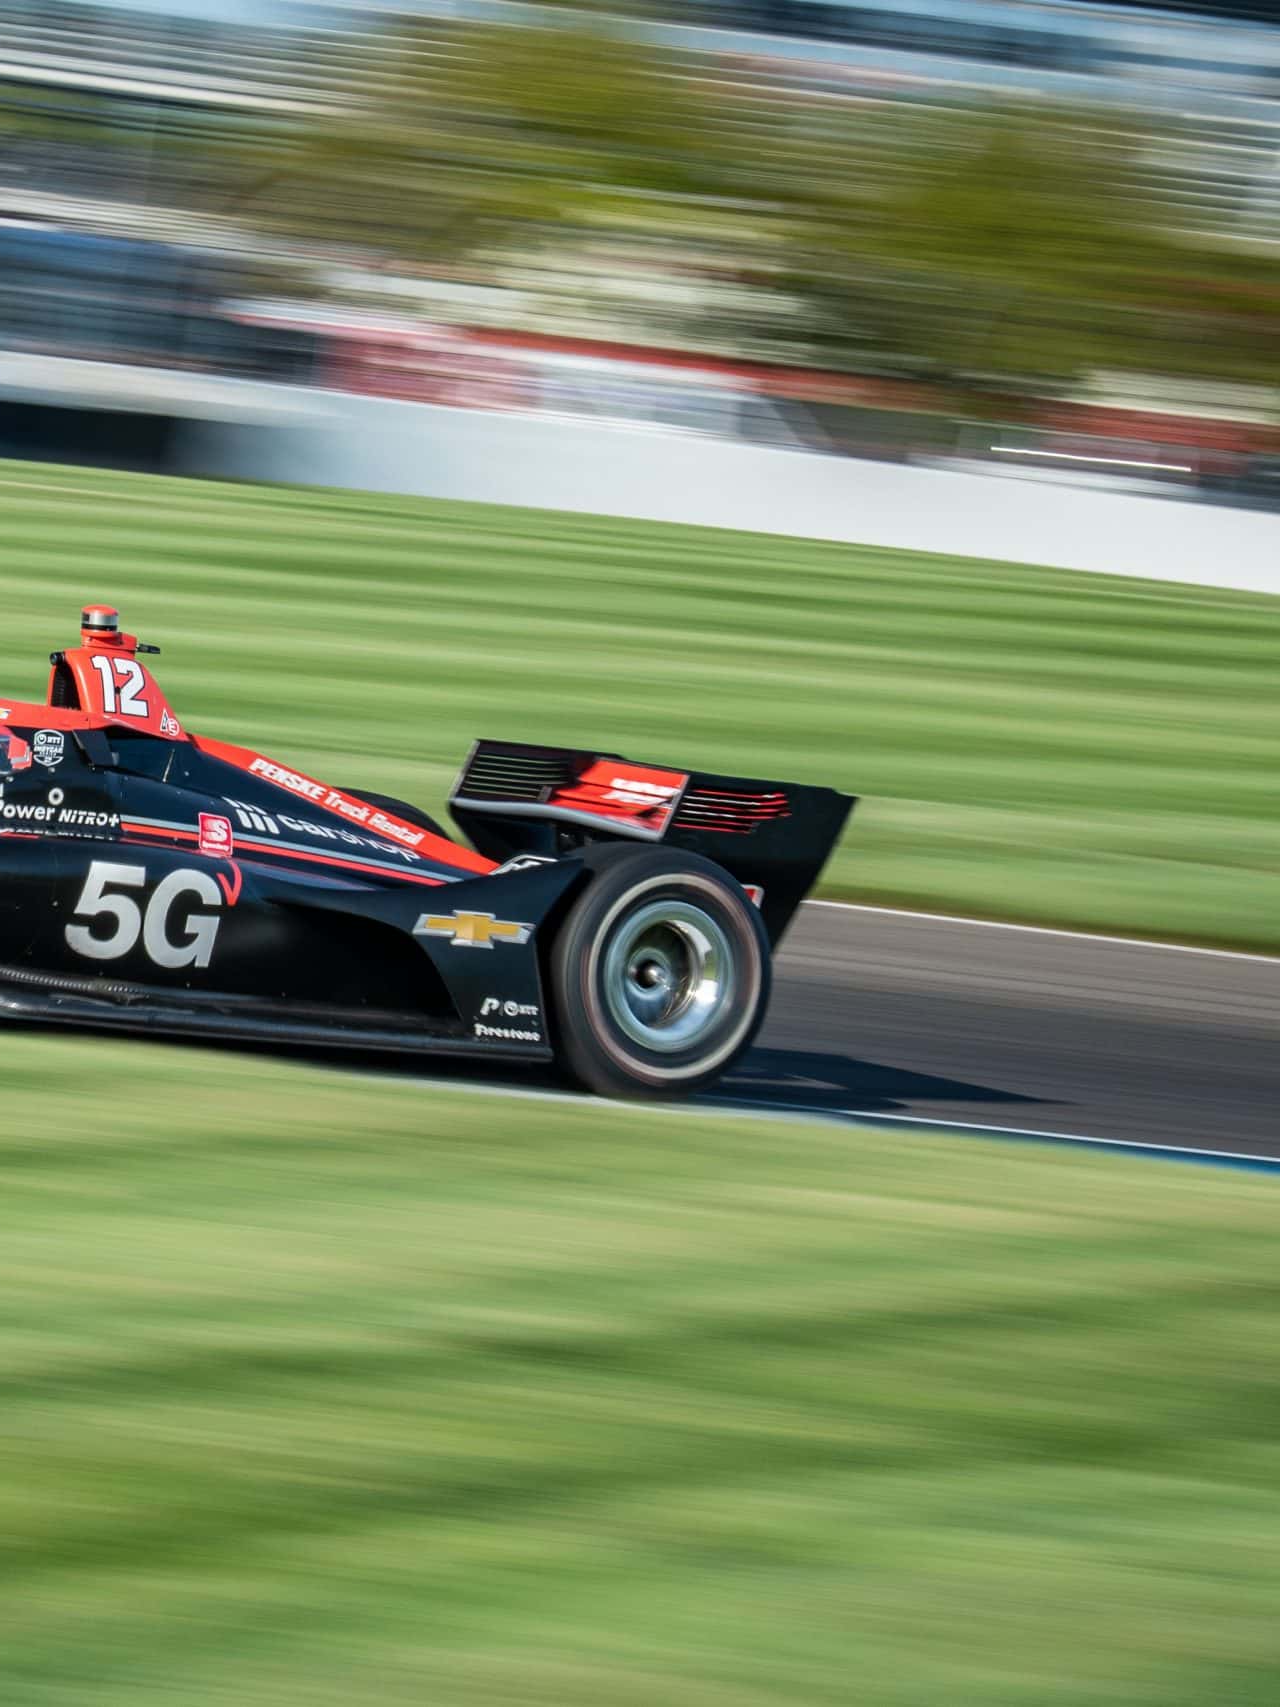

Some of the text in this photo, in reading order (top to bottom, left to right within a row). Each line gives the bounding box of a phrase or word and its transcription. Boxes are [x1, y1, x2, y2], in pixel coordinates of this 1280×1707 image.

[90, 654, 149, 718] 12
[248, 757, 425, 847] PENSKE Truck Rental
[64, 860, 223, 969] 5G
[474, 1022, 541, 1041] Firestone
